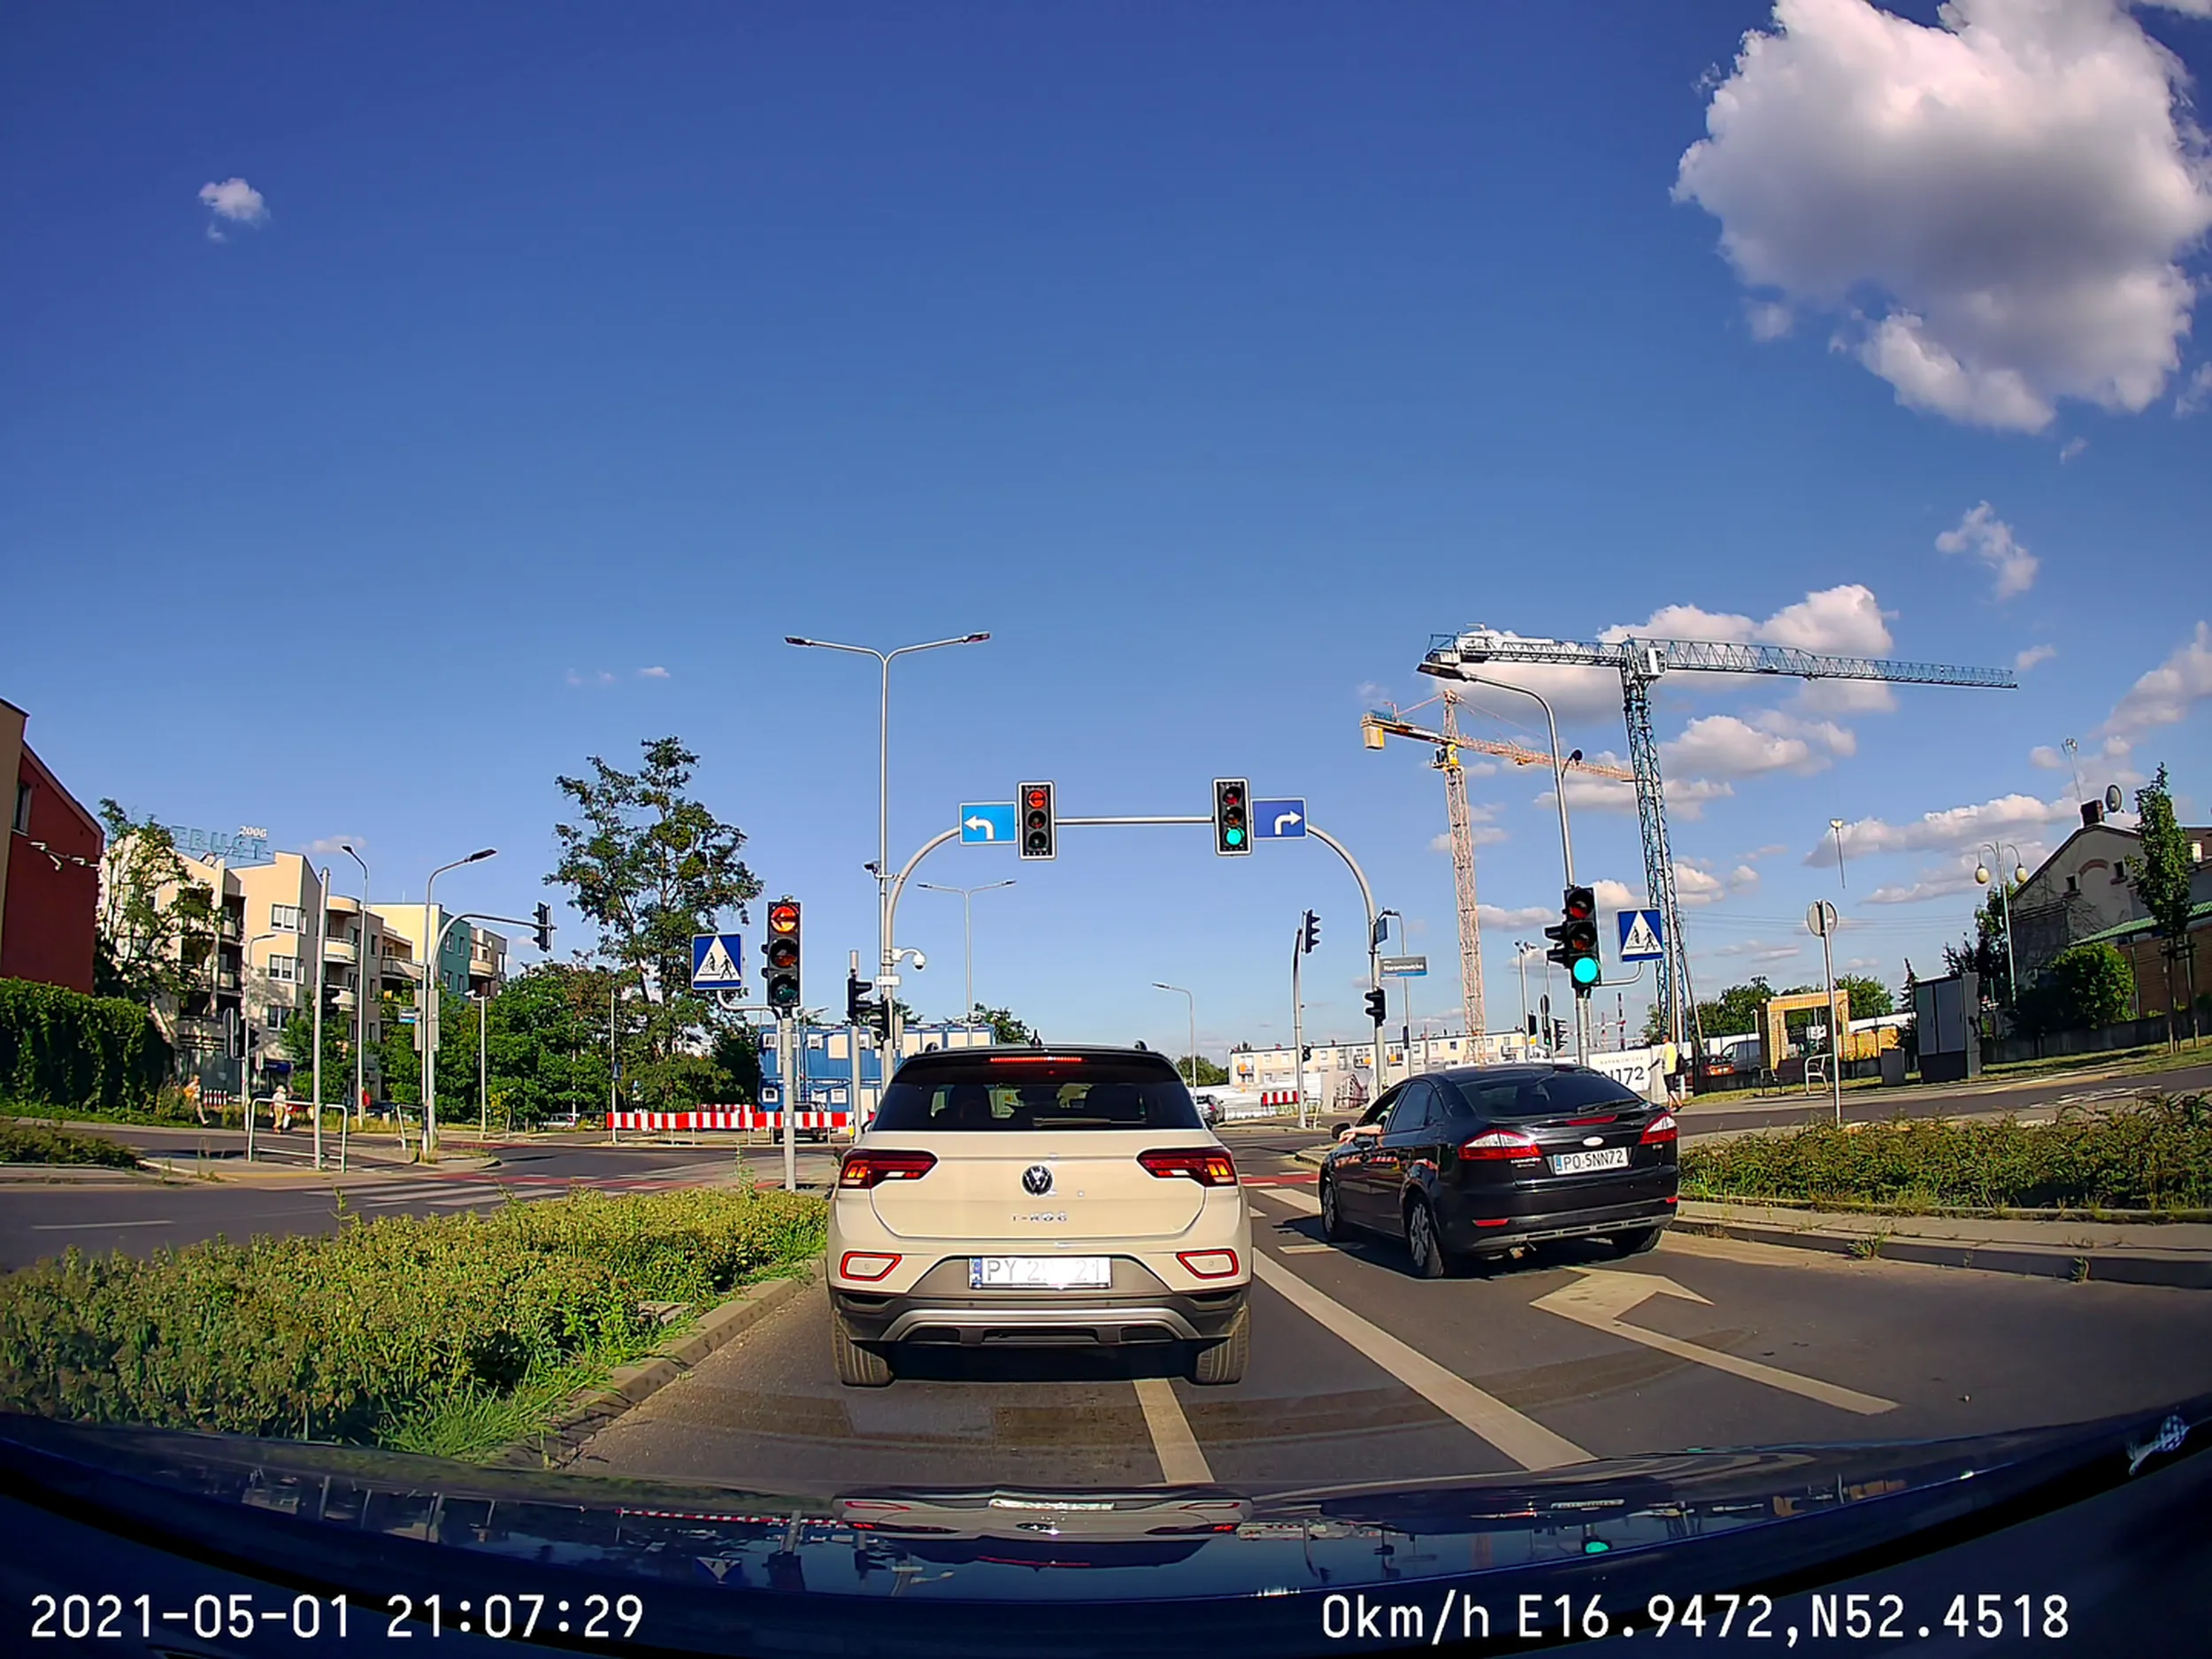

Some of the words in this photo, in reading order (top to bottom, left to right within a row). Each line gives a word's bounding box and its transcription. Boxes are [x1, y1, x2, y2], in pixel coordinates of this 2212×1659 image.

[1563, 1155, 1581, 1170] PO
[1586, 1149, 1624, 1168] 5NN72
[987, 1260, 1018, 1281] PY
[1027, 1260, 1100, 1281] 221
